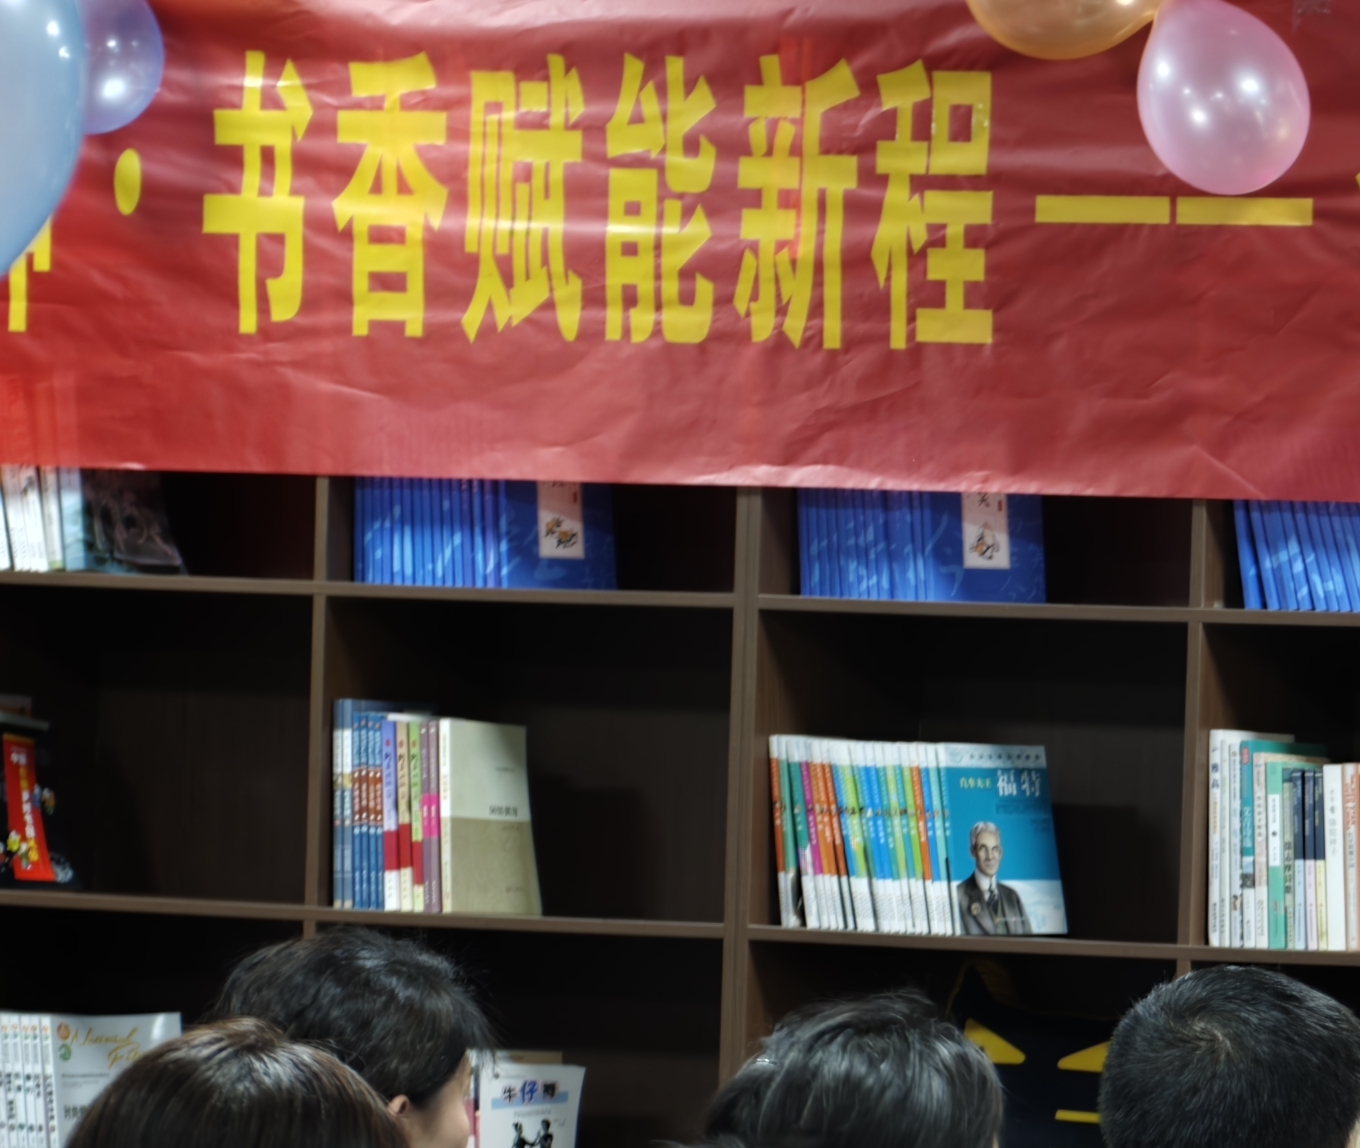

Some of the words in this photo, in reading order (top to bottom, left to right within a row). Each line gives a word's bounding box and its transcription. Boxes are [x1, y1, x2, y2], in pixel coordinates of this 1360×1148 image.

[997, 770, 1040, 797] 福特
[501, 1080, 559, 1104] 牛仔舞
